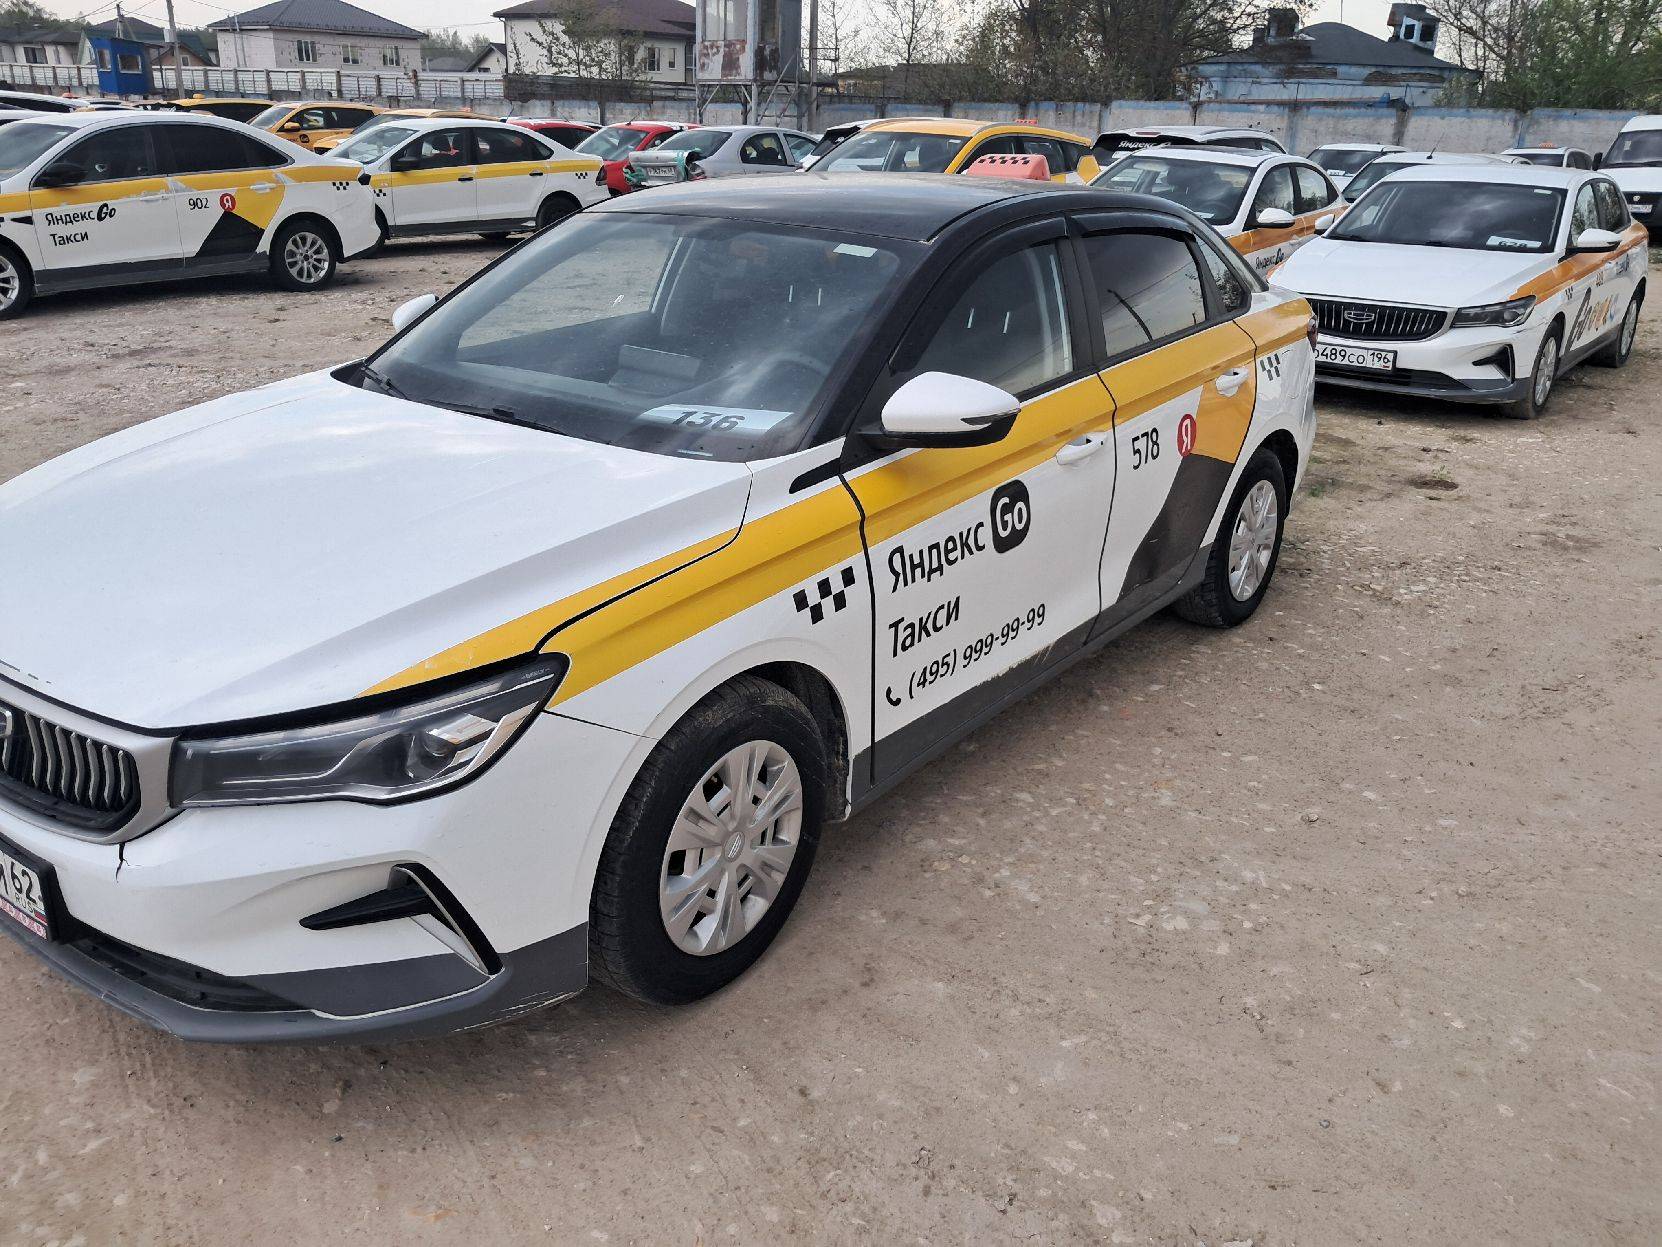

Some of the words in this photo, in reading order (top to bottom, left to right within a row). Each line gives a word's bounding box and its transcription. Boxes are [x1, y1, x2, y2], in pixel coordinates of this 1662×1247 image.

[45, 210, 95, 226] Яндекс
[97, 203, 116, 222] Go
[188, 197, 210, 211] 902
[50, 231, 89, 247] Такси
[1369, 352, 1391, 364] 196
[672, 411, 745, 432] 136
[1132, 427, 1160, 470] 578
[888, 521, 986, 594] Яндекс
[996, 497, 1028, 538] Go
[888, 595, 961, 658] Такси
[908, 648, 957, 699] (495)
[962, 603, 1046, 669] 999-99-99
[10, 861, 37, 904] 62
[14, 892, 35, 914] RUS
